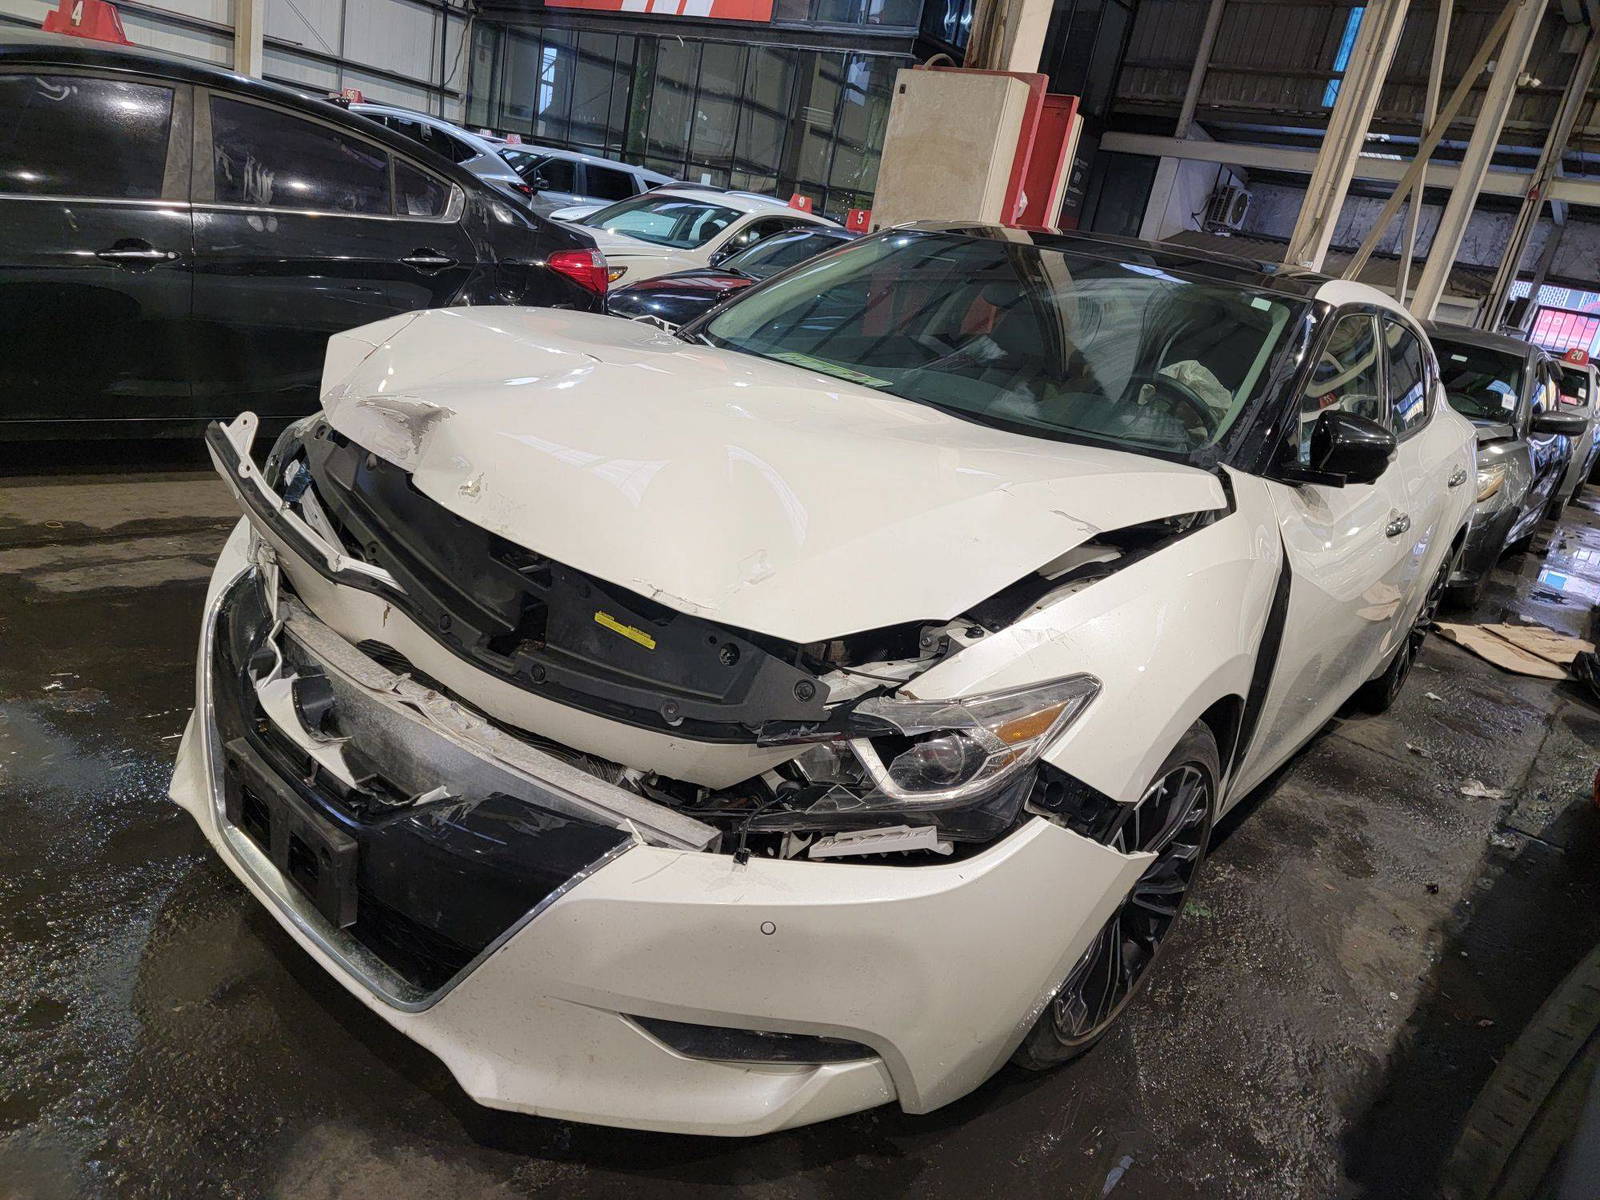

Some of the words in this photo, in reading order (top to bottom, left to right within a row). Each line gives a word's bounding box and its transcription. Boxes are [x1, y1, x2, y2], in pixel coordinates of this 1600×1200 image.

[72, 0, 84, 26] 4
[857, 211, 864, 225] 5
[1571, 350, 1583, 361] 20
